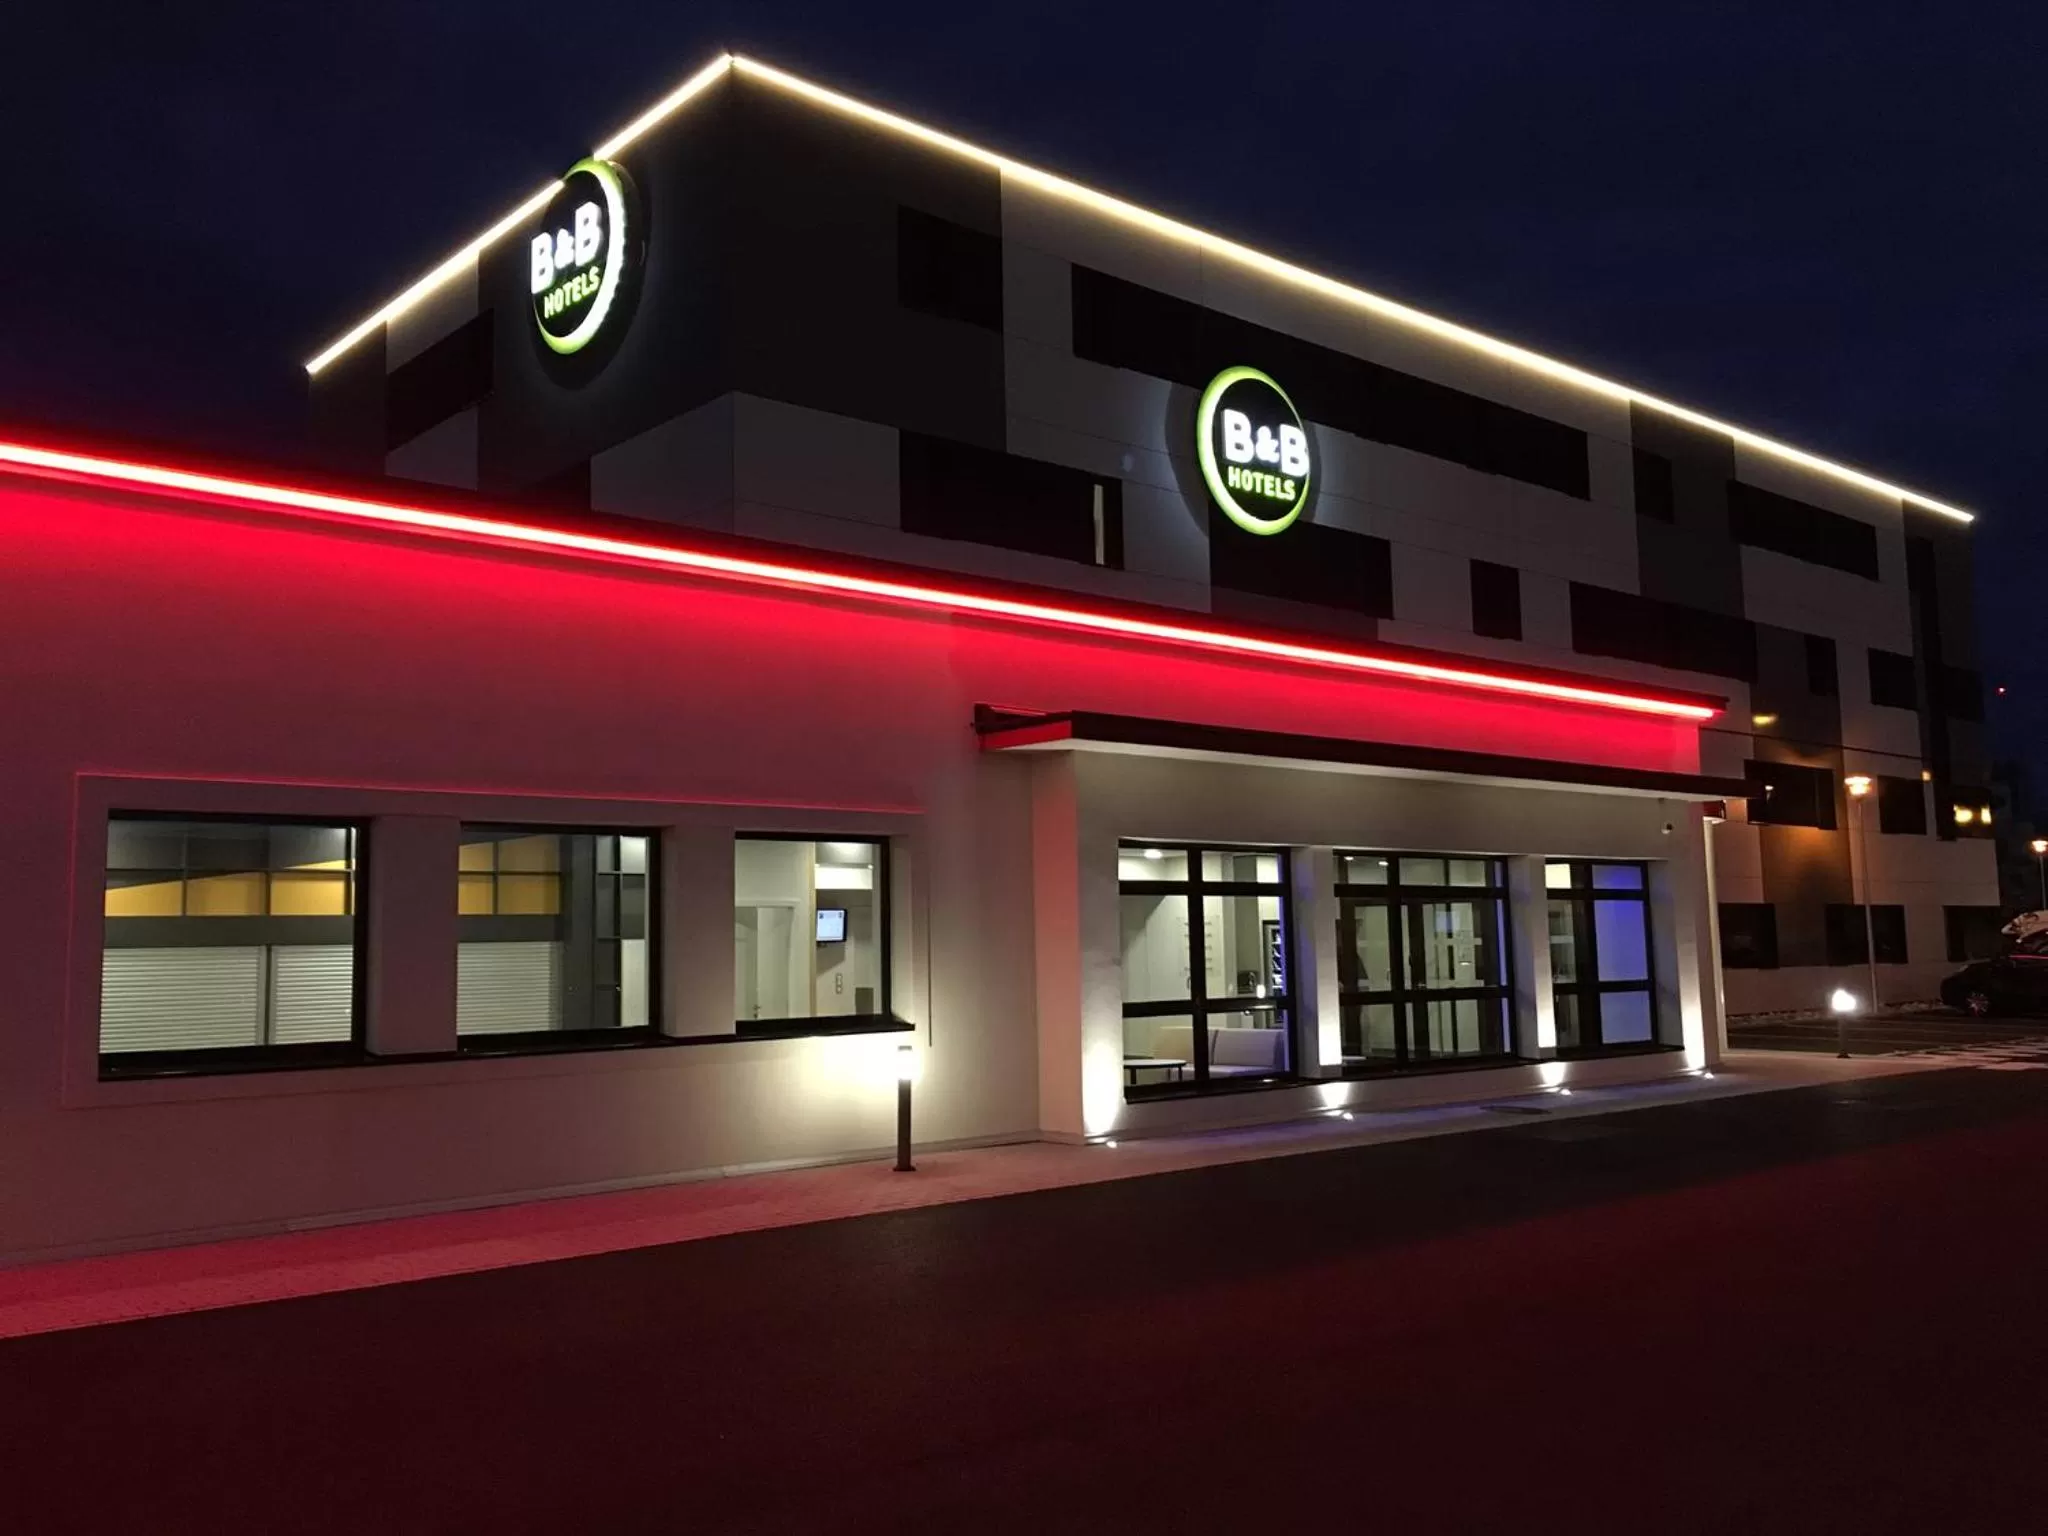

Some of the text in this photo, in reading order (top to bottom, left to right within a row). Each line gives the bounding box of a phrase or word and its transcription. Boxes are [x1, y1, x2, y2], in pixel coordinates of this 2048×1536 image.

[531, 201, 603, 294] B&B
[544, 266, 600, 319] HOTELS
[1223, 408, 1310, 477] B&B
[1227, 466, 1296, 501] HOTELS
